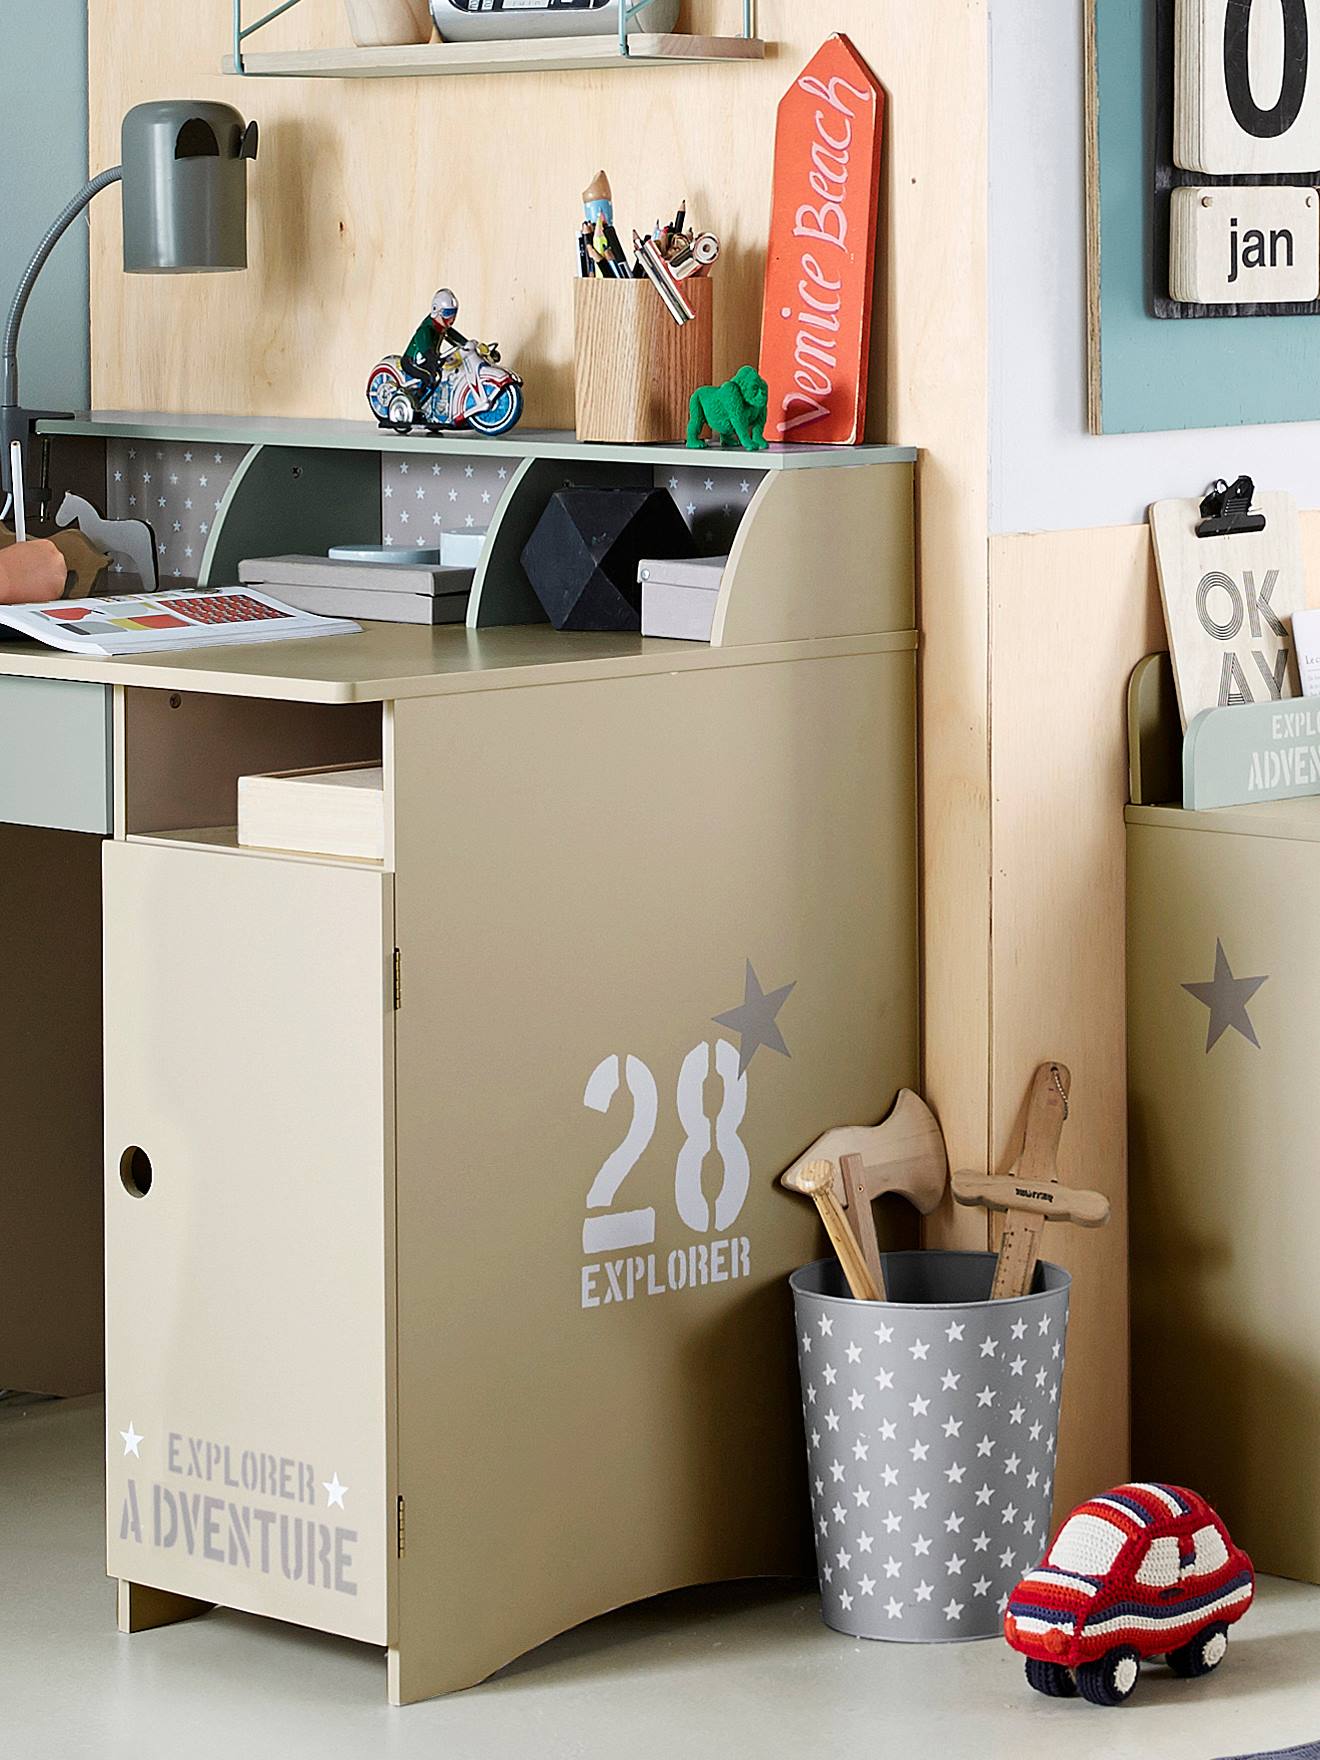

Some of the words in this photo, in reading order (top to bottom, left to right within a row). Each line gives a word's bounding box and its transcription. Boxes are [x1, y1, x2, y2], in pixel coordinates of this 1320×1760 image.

[792, 75, 871, 253] Beach
[1227, 217, 1294, 283] jan
[776, 252, 843, 433] Venice
[1195, 569, 1288, 641] OK
[1218, 648, 1289, 707] AY
[582, 1038, 751, 1254] 28
[581, 1236, 751, 1309] EXPLORER
[168, 1432, 316, 1505] EXPLORER
[119, 1478, 359, 1597] ADVENTURE
